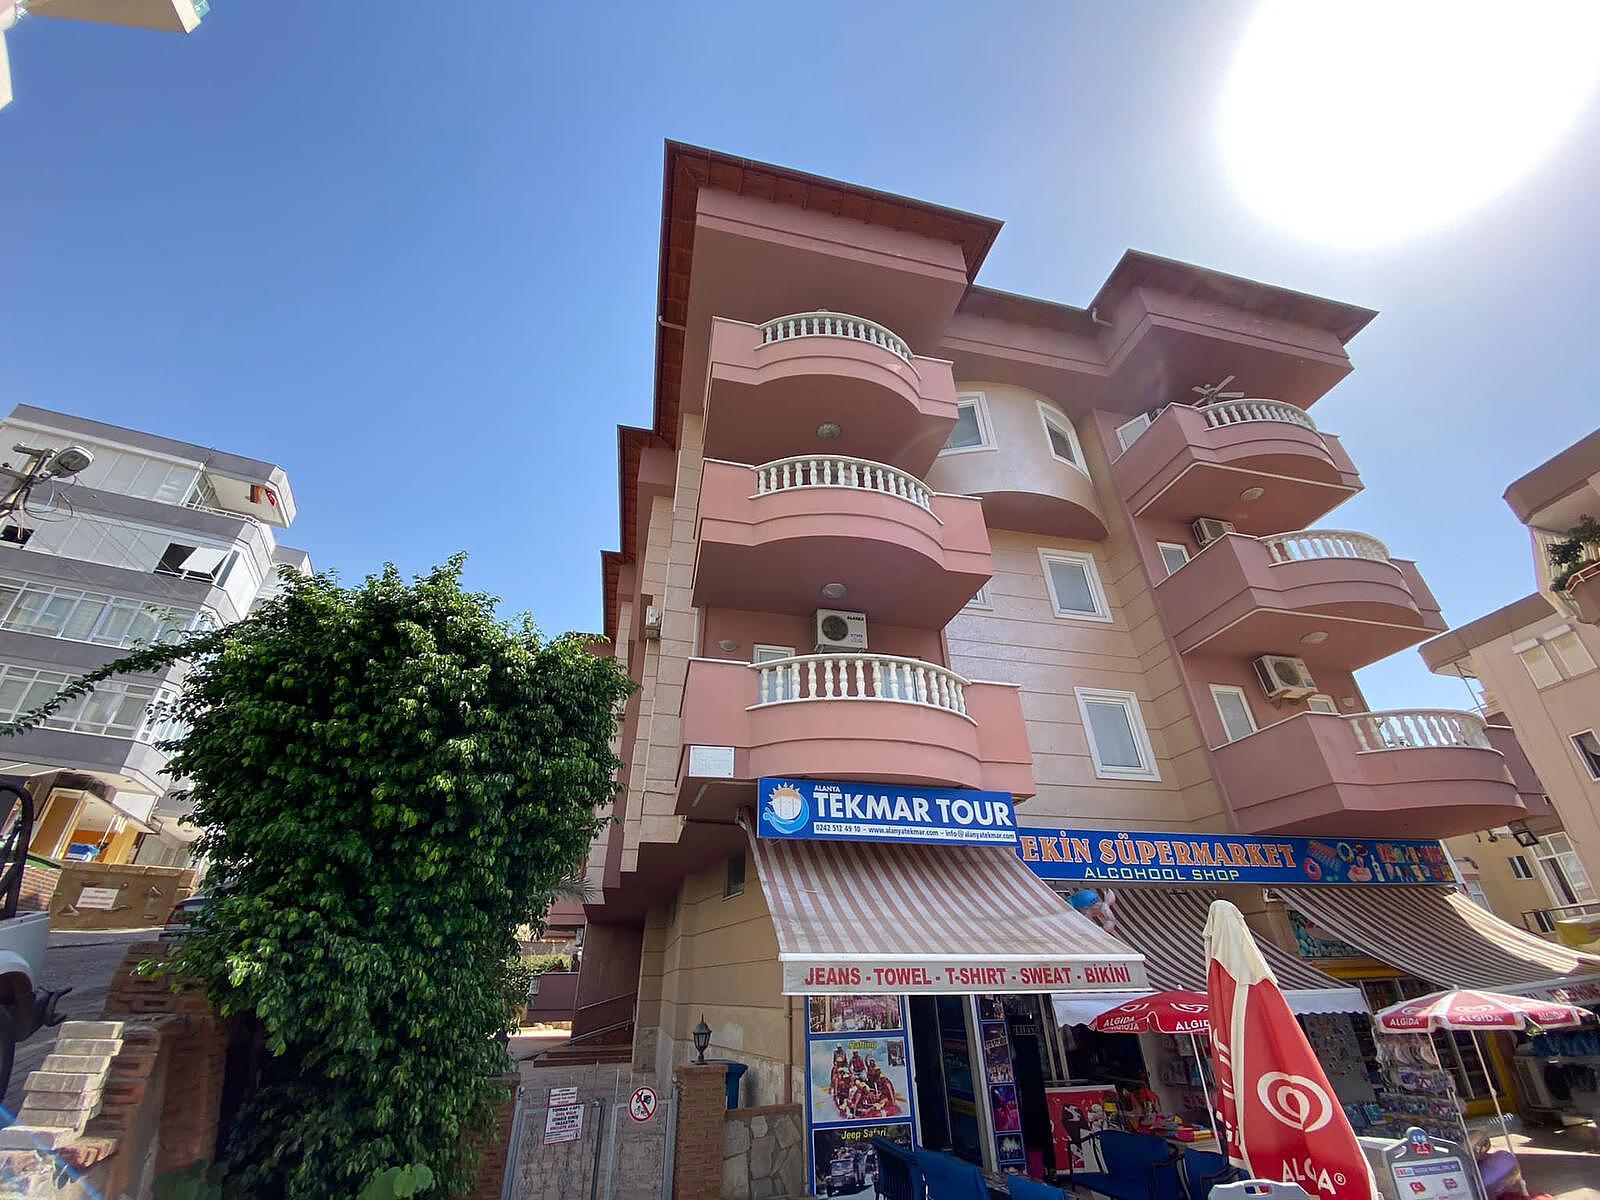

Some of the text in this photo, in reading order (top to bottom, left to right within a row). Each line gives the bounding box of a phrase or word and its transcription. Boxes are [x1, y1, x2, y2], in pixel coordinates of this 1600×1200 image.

[814, 785, 841, 793] ALANYA
[813, 793, 1013, 826] TEKMAR TOUR
[815, 824, 831, 832] 0242
[1099, 833, 1297, 868] SÜPERMARKET
[1084, 867, 1240, 881] ALCOHOOL SHOP
[804, 967, 862, 986] JEANS
[873, 968, 932, 985] TOWEL
[945, 967, 1006, 984] T-SHIRT
[1021, 967, 1071, 983] SWEAT
[1085, 963, 1131, 983] BİKİNİ
[1175, 1019, 1209, 1031] ALGID
[841, 1131, 861, 1140] Jeep
